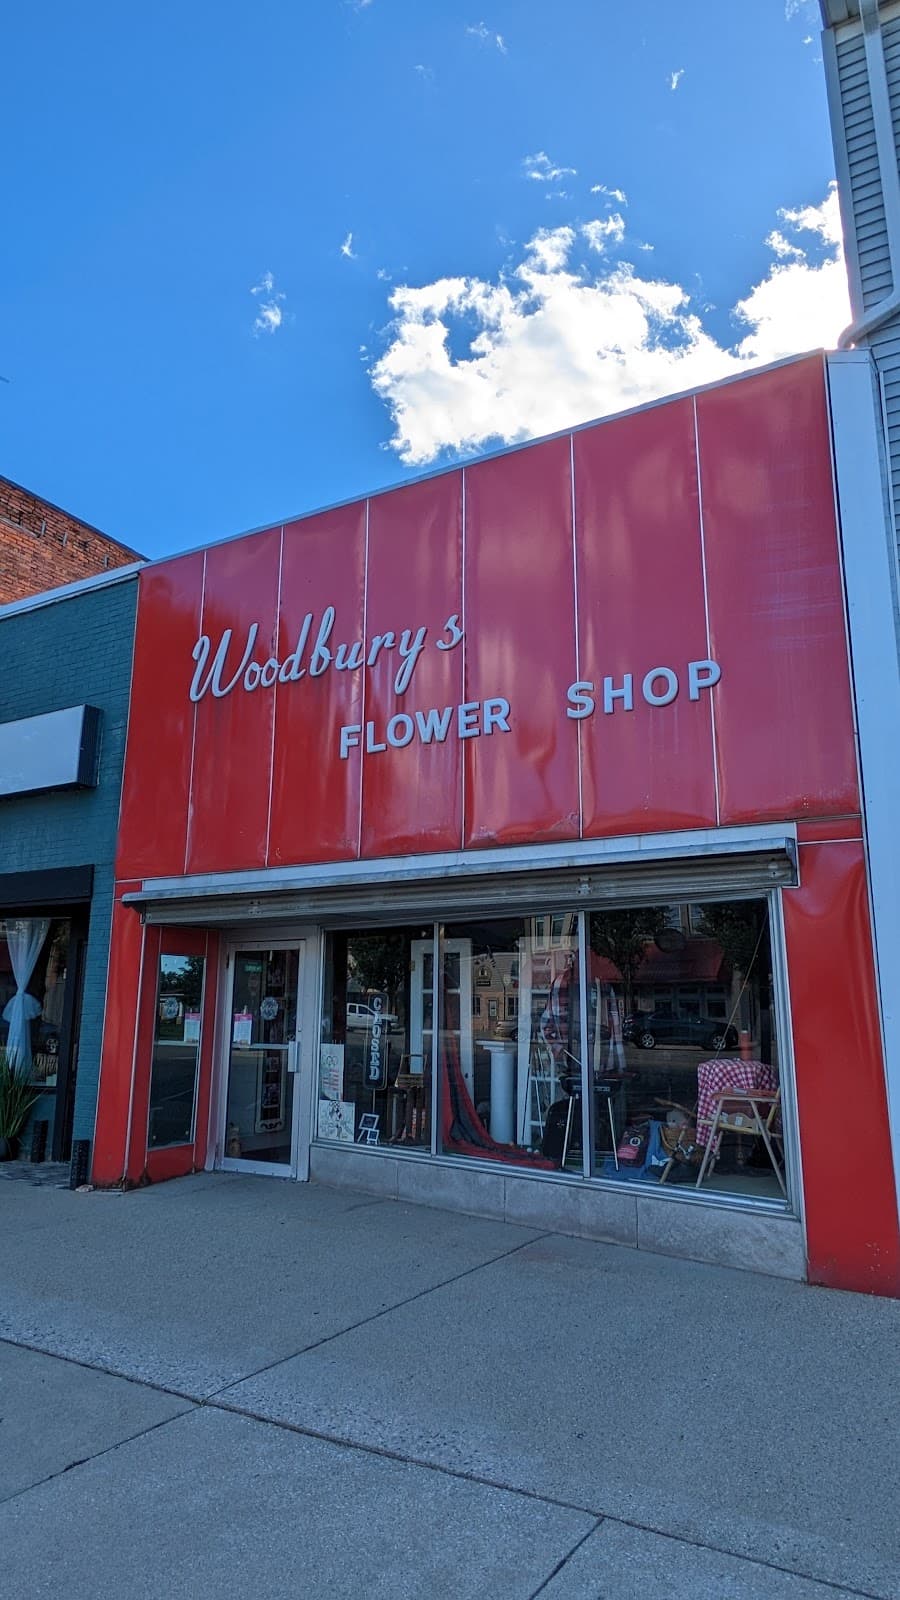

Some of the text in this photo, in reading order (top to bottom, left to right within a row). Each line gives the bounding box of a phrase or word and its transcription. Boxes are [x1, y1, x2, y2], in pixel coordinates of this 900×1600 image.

[339, 659, 722, 760] FLOWER SHOP
[369, 997, 382, 1080] CLOSED
